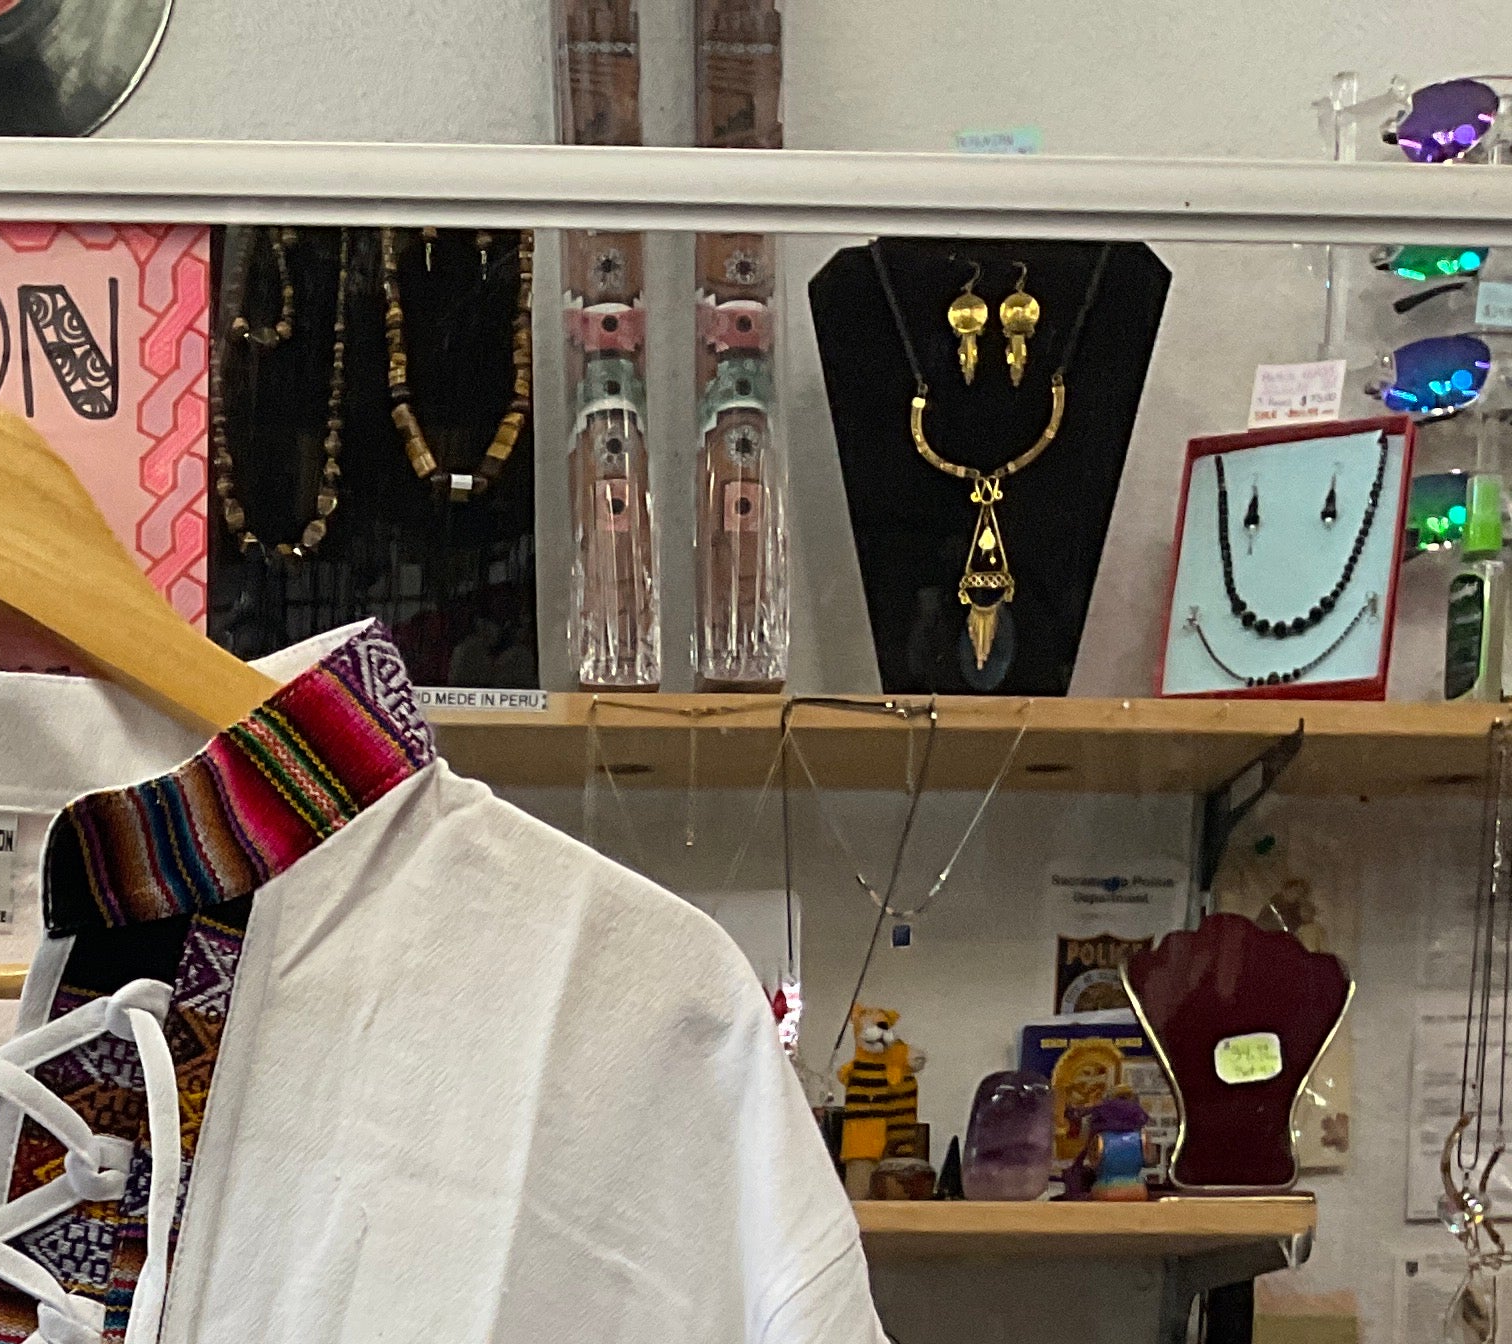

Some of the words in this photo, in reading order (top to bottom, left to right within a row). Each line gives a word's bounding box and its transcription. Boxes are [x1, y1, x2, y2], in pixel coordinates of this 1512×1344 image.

[435, 692, 477, 706] MEDE
[480, 693, 496, 707] IN
[499, 694, 539, 708] PERU
